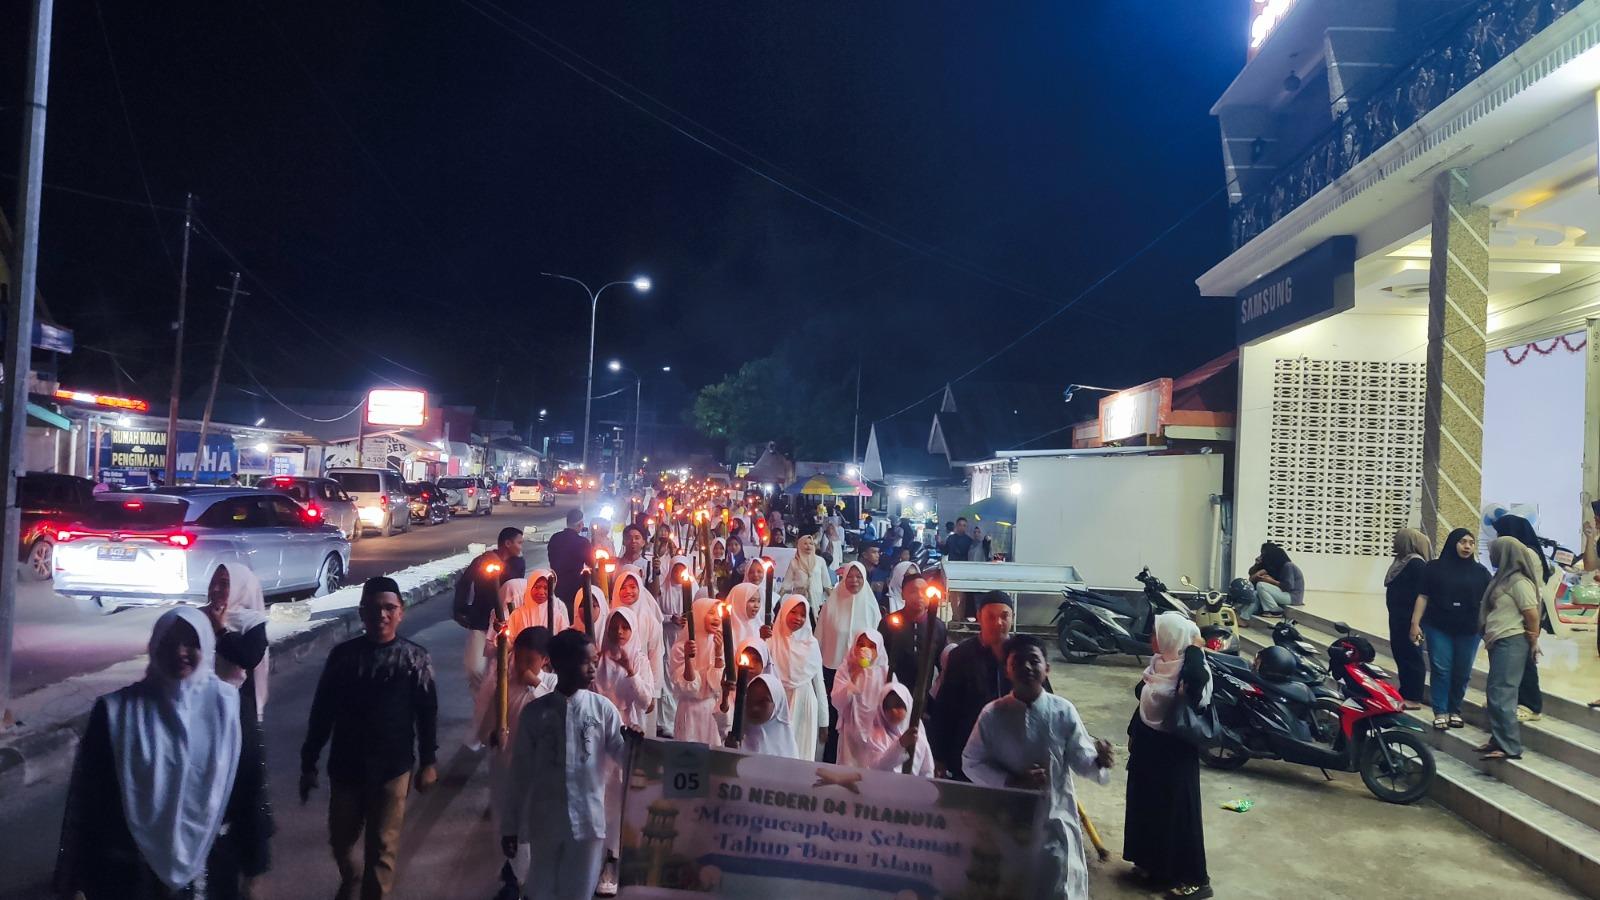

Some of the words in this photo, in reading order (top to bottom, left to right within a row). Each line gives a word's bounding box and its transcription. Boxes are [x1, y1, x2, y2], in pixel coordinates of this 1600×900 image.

[1242, 277, 1292, 323] SAMSUNG
[112, 430, 139, 444] RUMAH
[139, 431, 167, 446] MAKAN
[112, 452, 166, 467] PENGINAPAN
[673, 772, 700, 790] 05
[718, 782, 743, 801] SD
[749, 787, 818, 813] NEGERI
[823, 797, 847, 816] 04
[854, 802, 947, 830] TILAMUTA
[693, 804, 863, 842] Mengucapkan
[868, 828, 961, 856] Selamat
[713, 825, 790, 857] Tahun
[796, 841, 859, 864] Baru
[865, 851, 933, 876] Islam
